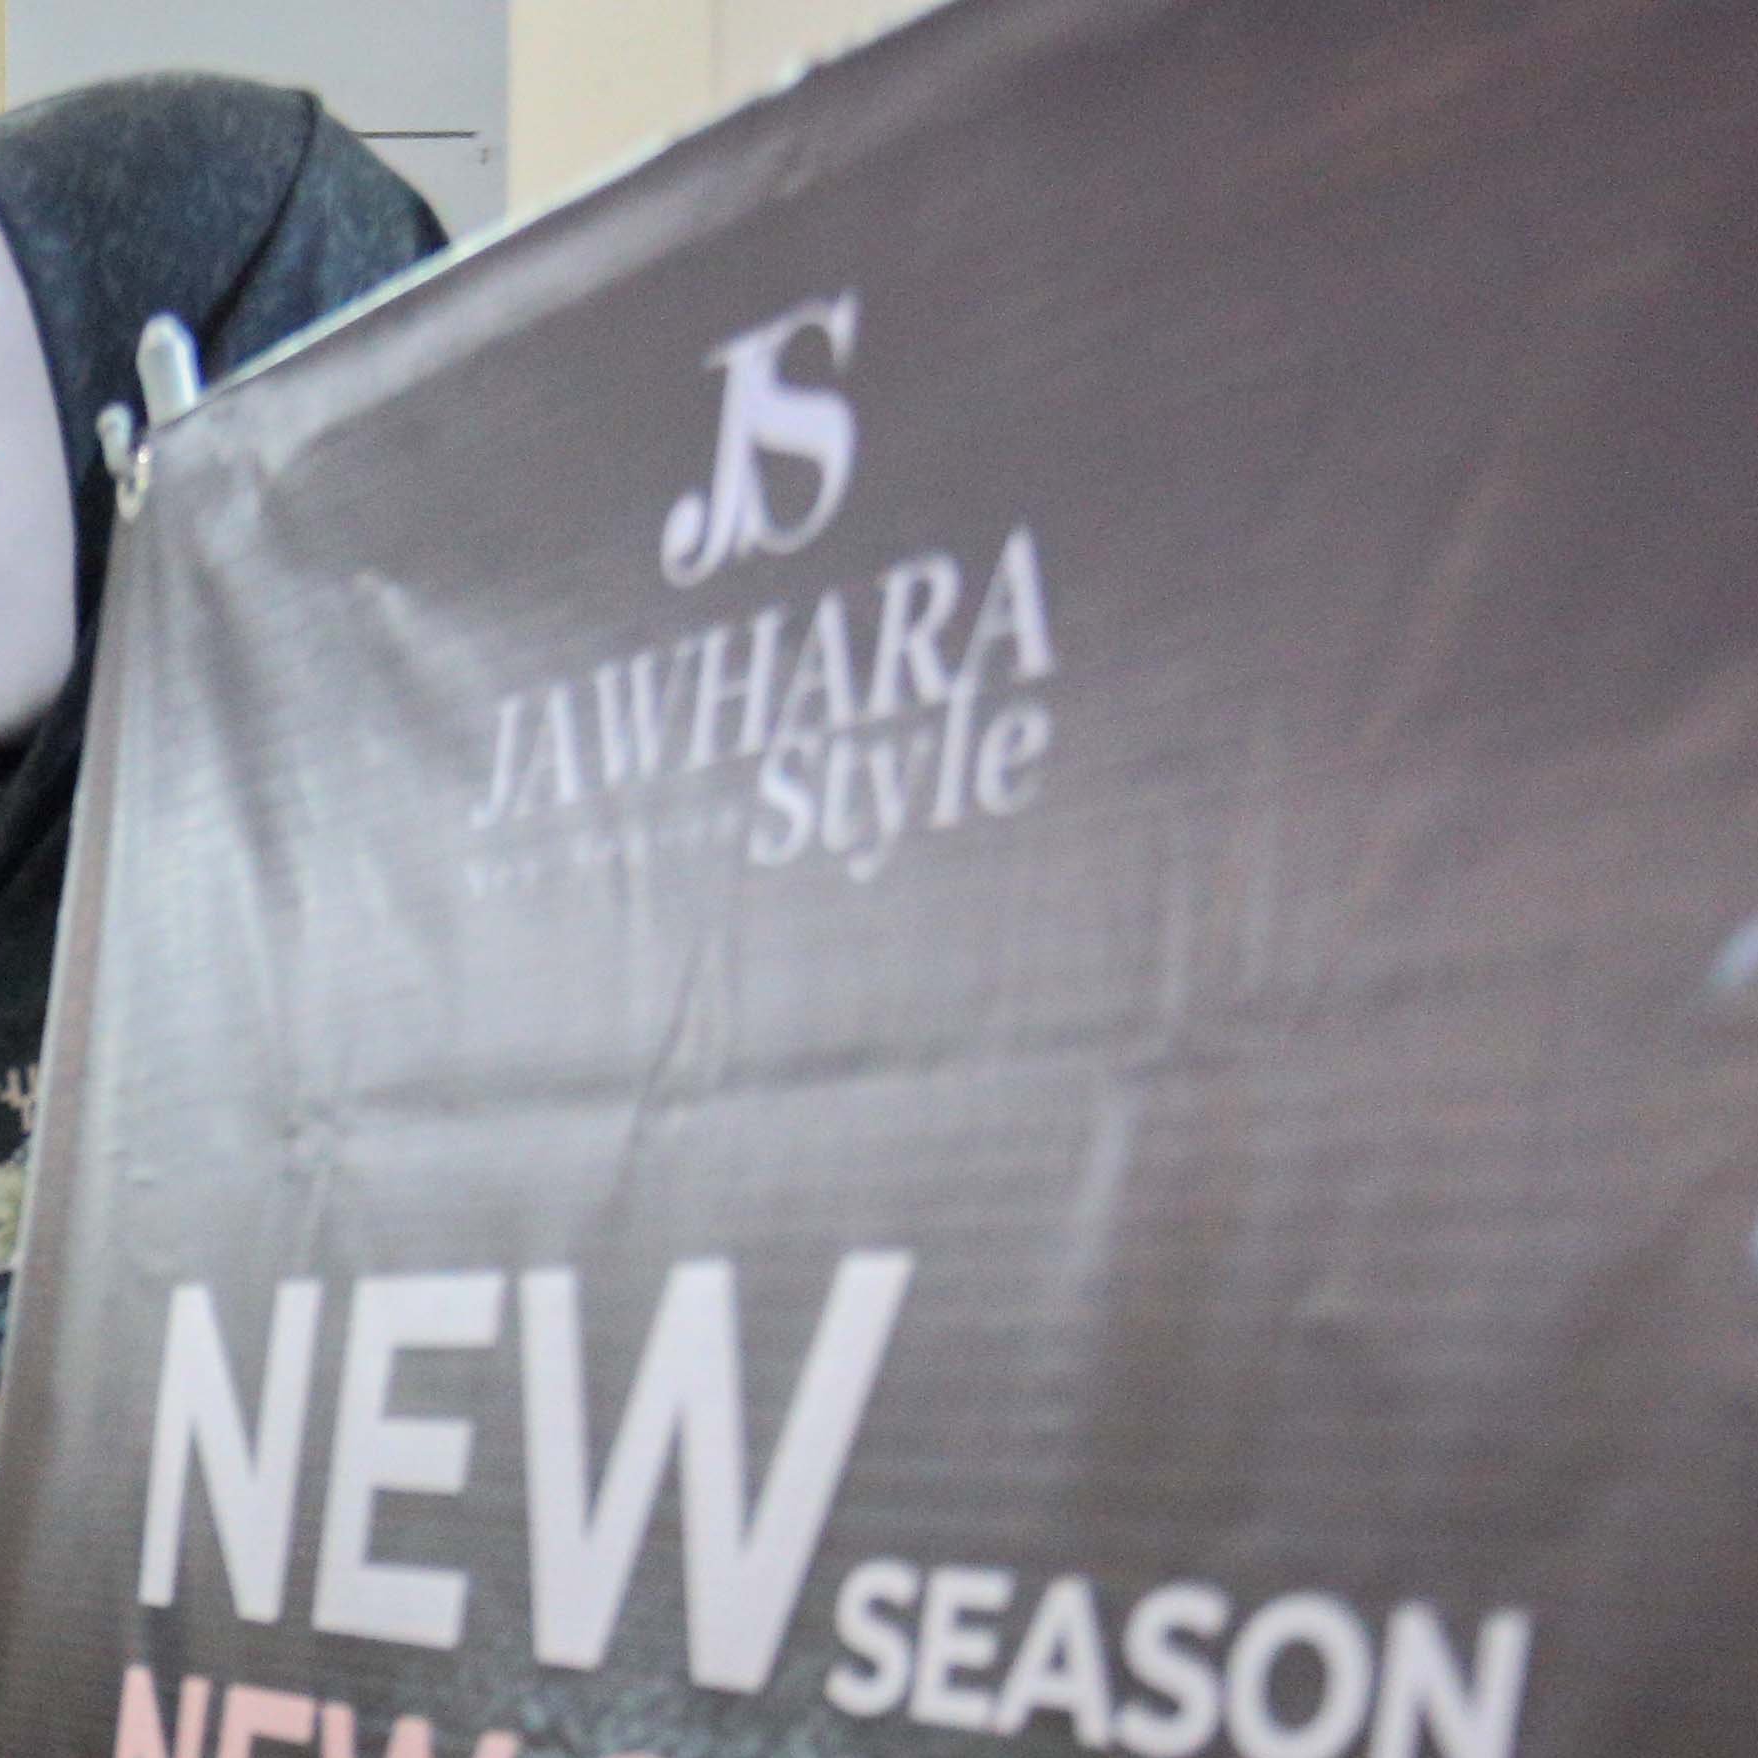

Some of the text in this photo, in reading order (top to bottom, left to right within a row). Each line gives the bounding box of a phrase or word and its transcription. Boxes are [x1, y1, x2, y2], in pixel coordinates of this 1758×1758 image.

[468, 523, 1058, 830] JAWHARA
[748, 682, 1053, 883] Style
[137, 1250, 918, 1695] NEW
